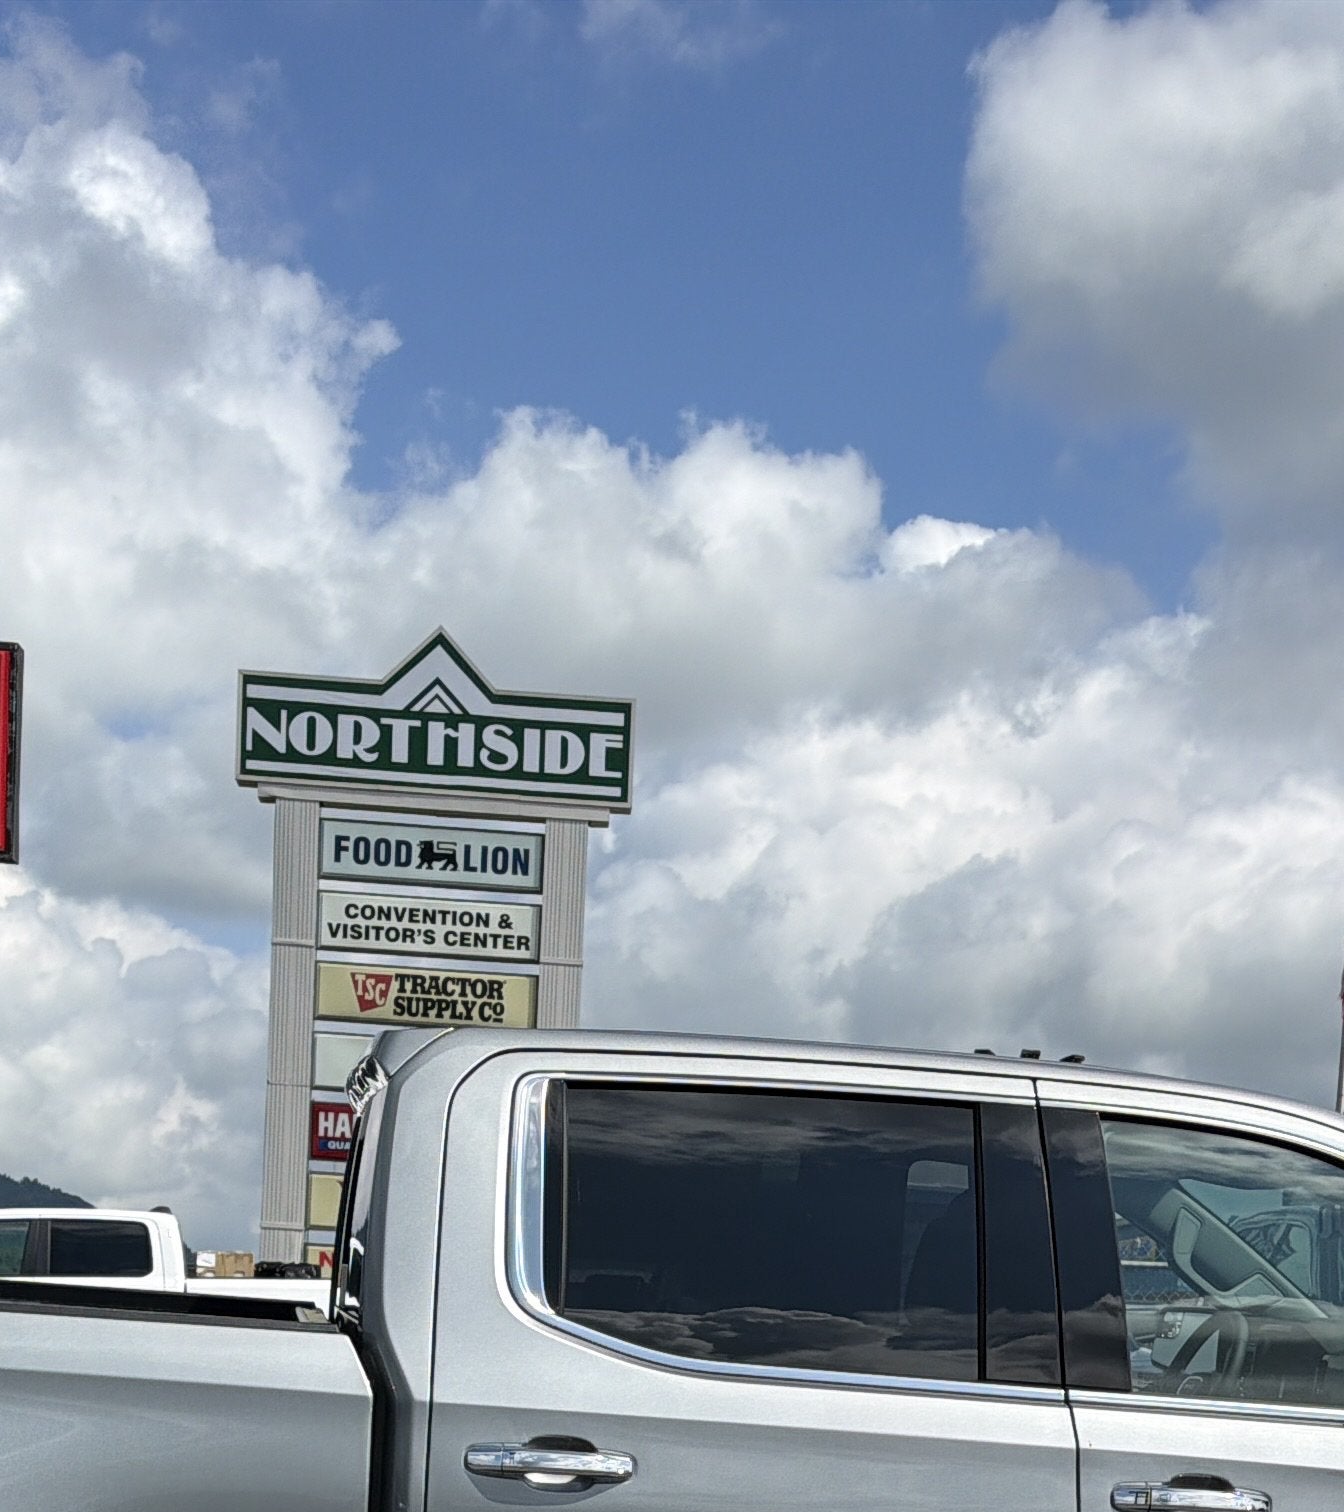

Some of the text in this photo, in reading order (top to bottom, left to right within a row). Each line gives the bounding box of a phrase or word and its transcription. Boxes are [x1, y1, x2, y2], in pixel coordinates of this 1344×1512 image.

[244, 706, 624, 778] NORTHSIDE
[333, 835, 530, 876] FOOD LION
[344, 903, 514, 930] CONVENTION &
[327, 922, 530, 951] VISITOR'S CENTER
[354, 973, 386, 1007] TSC
[394, 973, 505, 1000] TRACTOR
[393, 995, 478, 1022] SUPPLY
